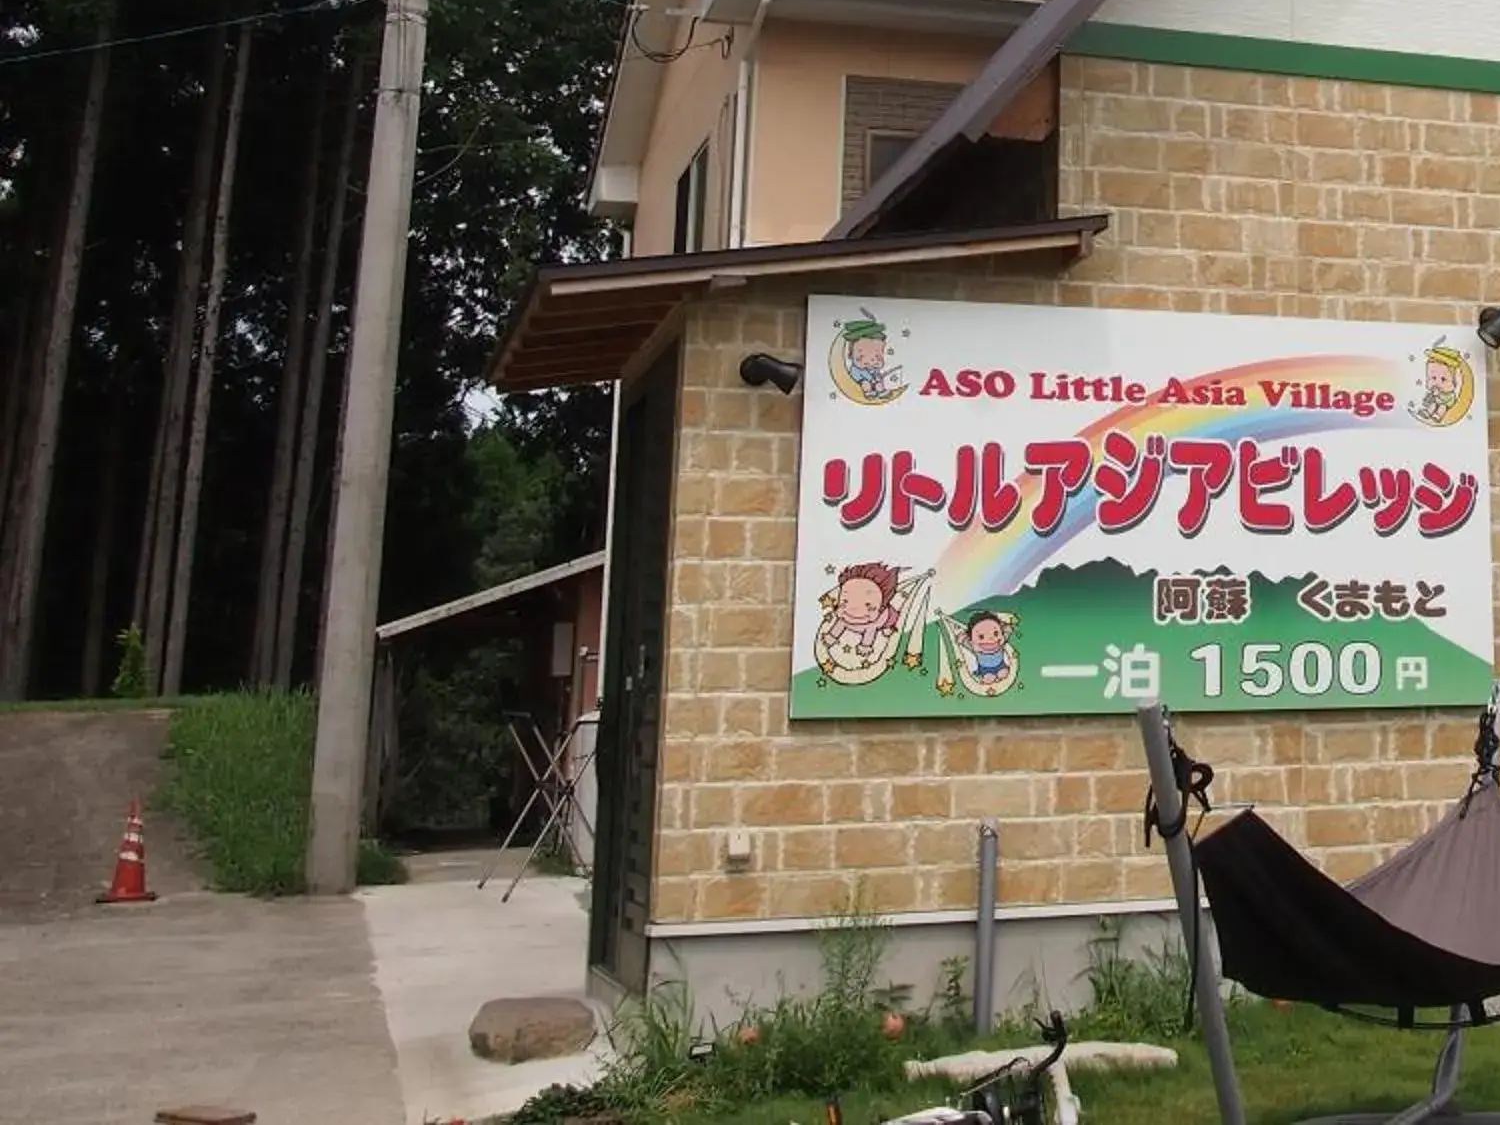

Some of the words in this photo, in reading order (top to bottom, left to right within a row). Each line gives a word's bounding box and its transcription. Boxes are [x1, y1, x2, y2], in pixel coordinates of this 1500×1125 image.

[919, 368, 1016, 398] ASO
[1029, 372, 1147, 403] Little
[1157, 377, 1247, 406] Asia
[1258, 380, 1396, 417] Village
[823, 433, 1478, 536] リトルアジアビレッジ
[1155, 577, 1252, 621] 阿蘇
[1299, 578, 1448, 619] くまもと
[1040, 643, 1162, 699] 一泊
[1190, 640, 1382, 698] 1500
[1395, 655, 1429, 691] 円
